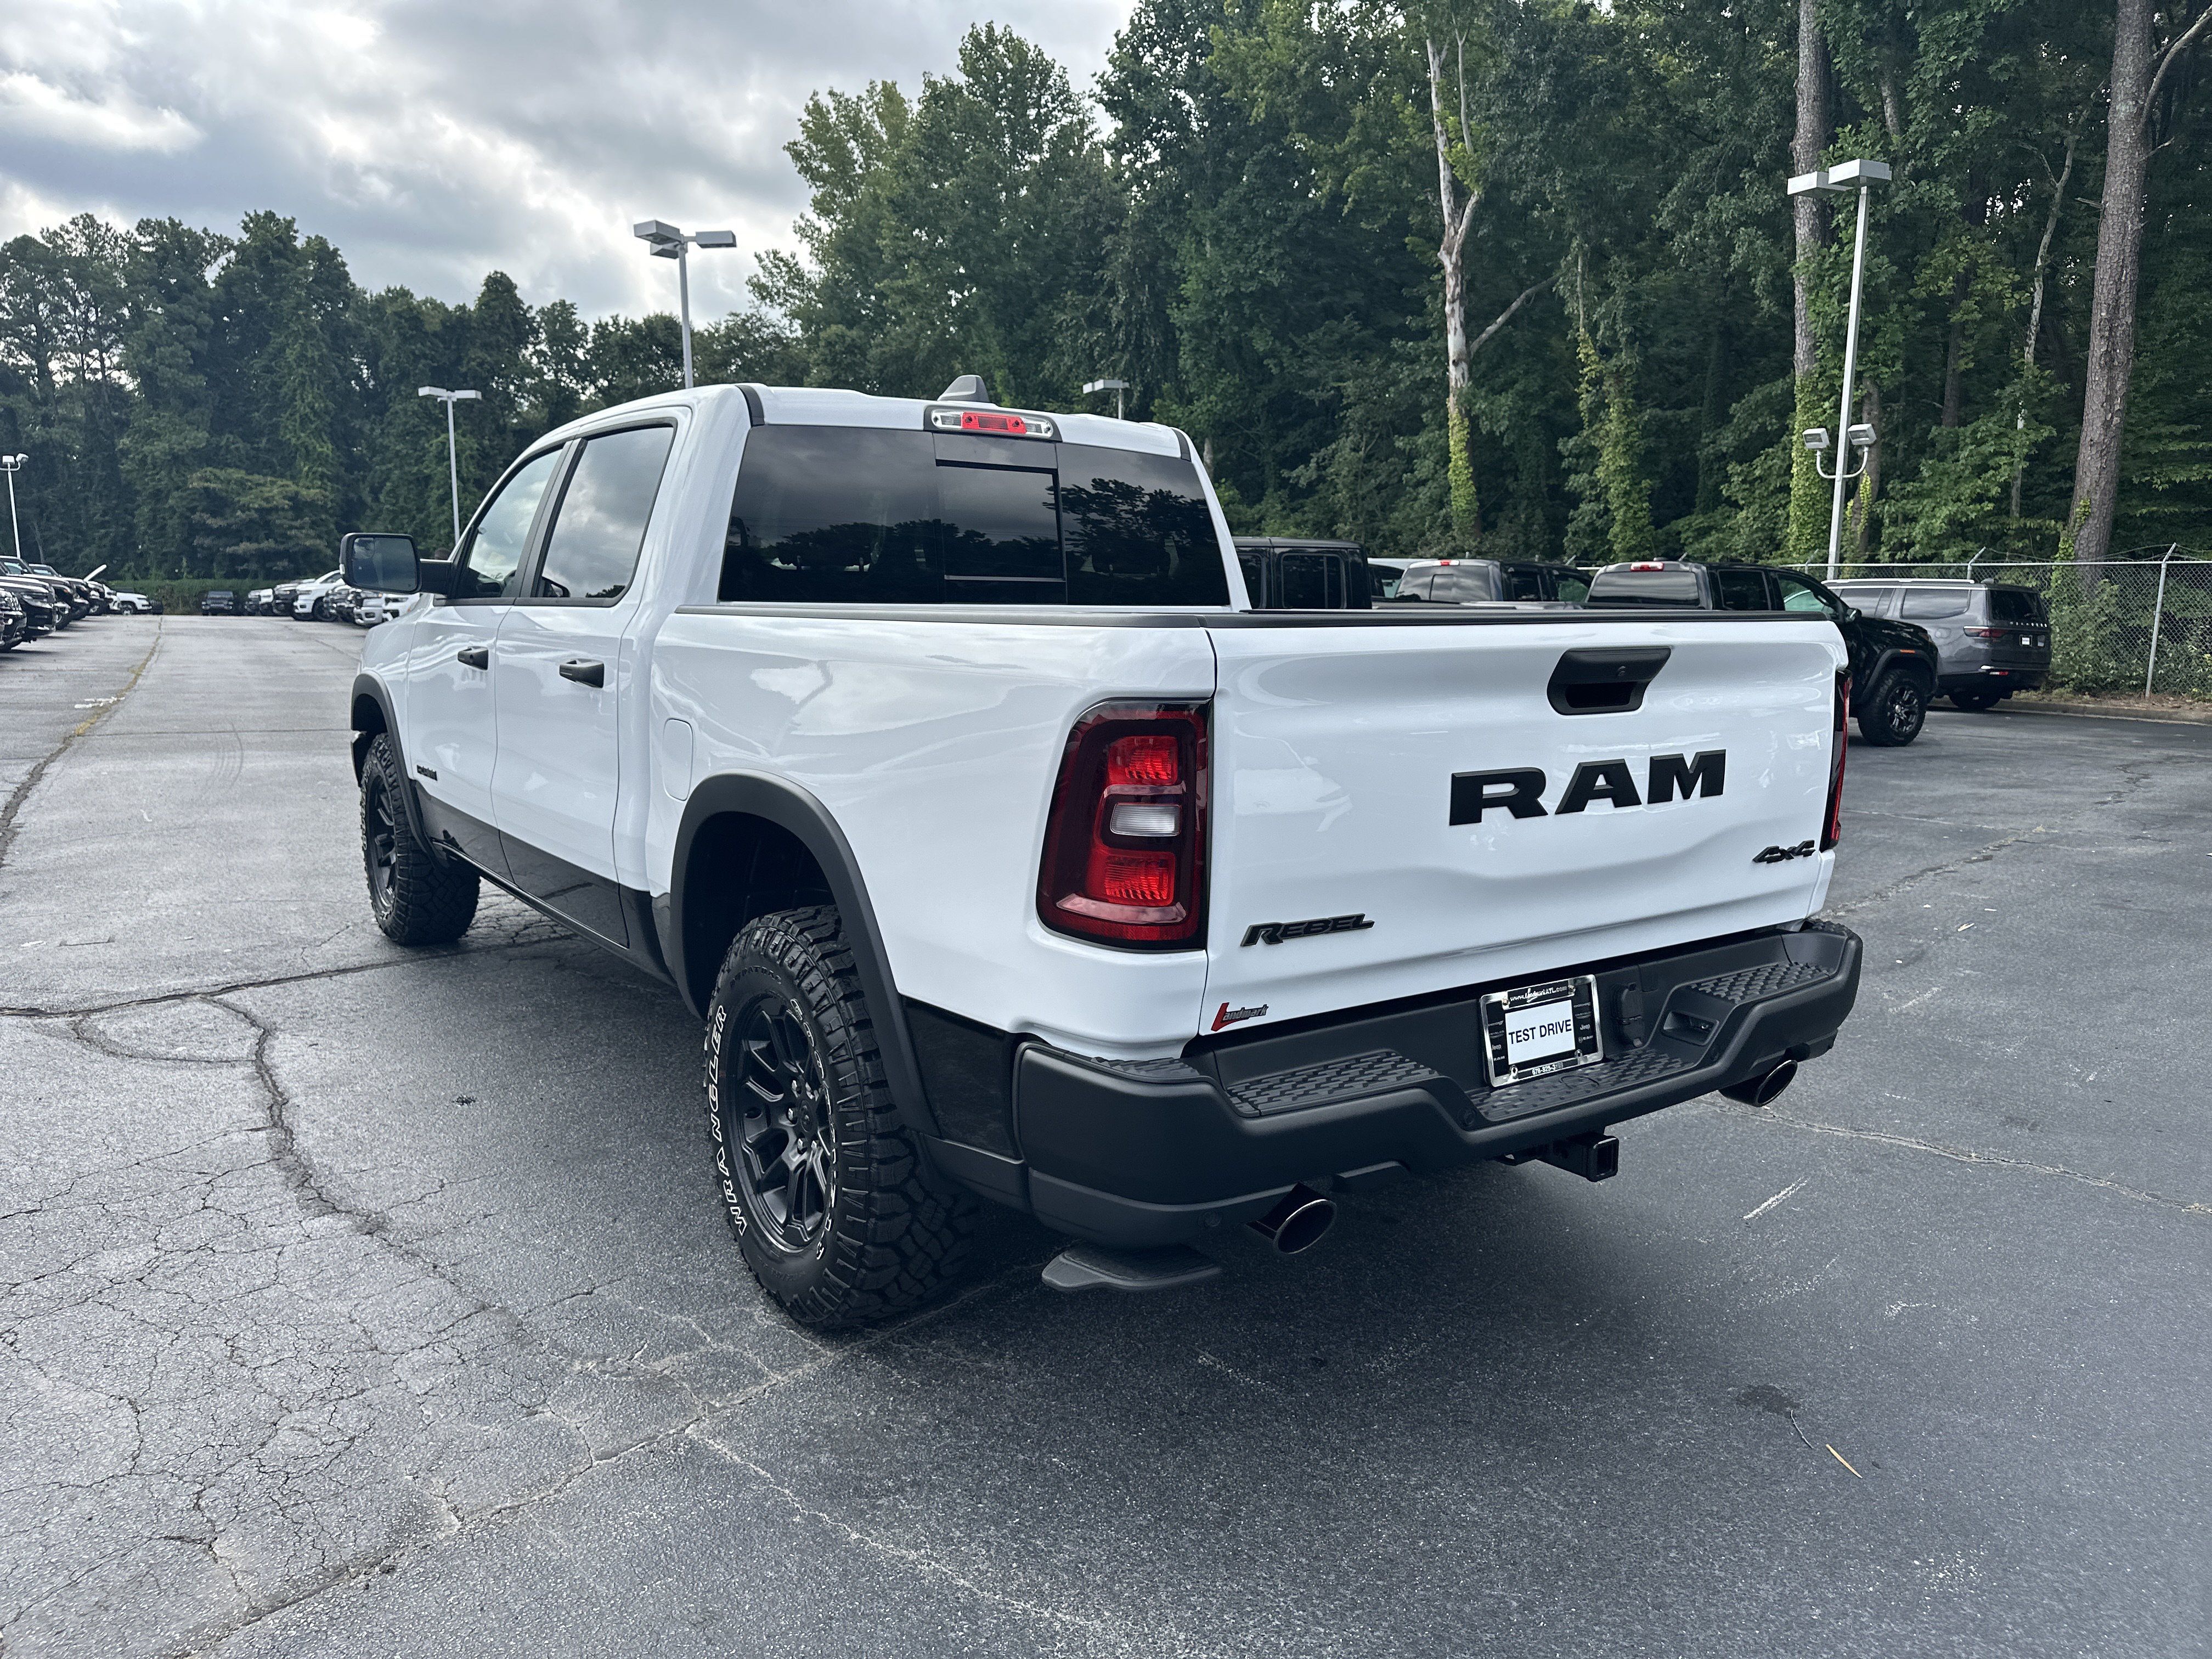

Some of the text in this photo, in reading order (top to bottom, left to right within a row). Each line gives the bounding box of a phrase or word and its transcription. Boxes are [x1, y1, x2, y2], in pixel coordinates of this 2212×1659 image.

[1449, 749, 1726, 826] RAM
[1752, 840, 1816, 864] 4x4
[1240, 913, 1375, 947] REBEL
[1211, 1002, 1269, 1031] Landmark
[1508, 1019, 1572, 1045] TEST DRIVE
[709, 1005, 747, 1236] WRANGLER
